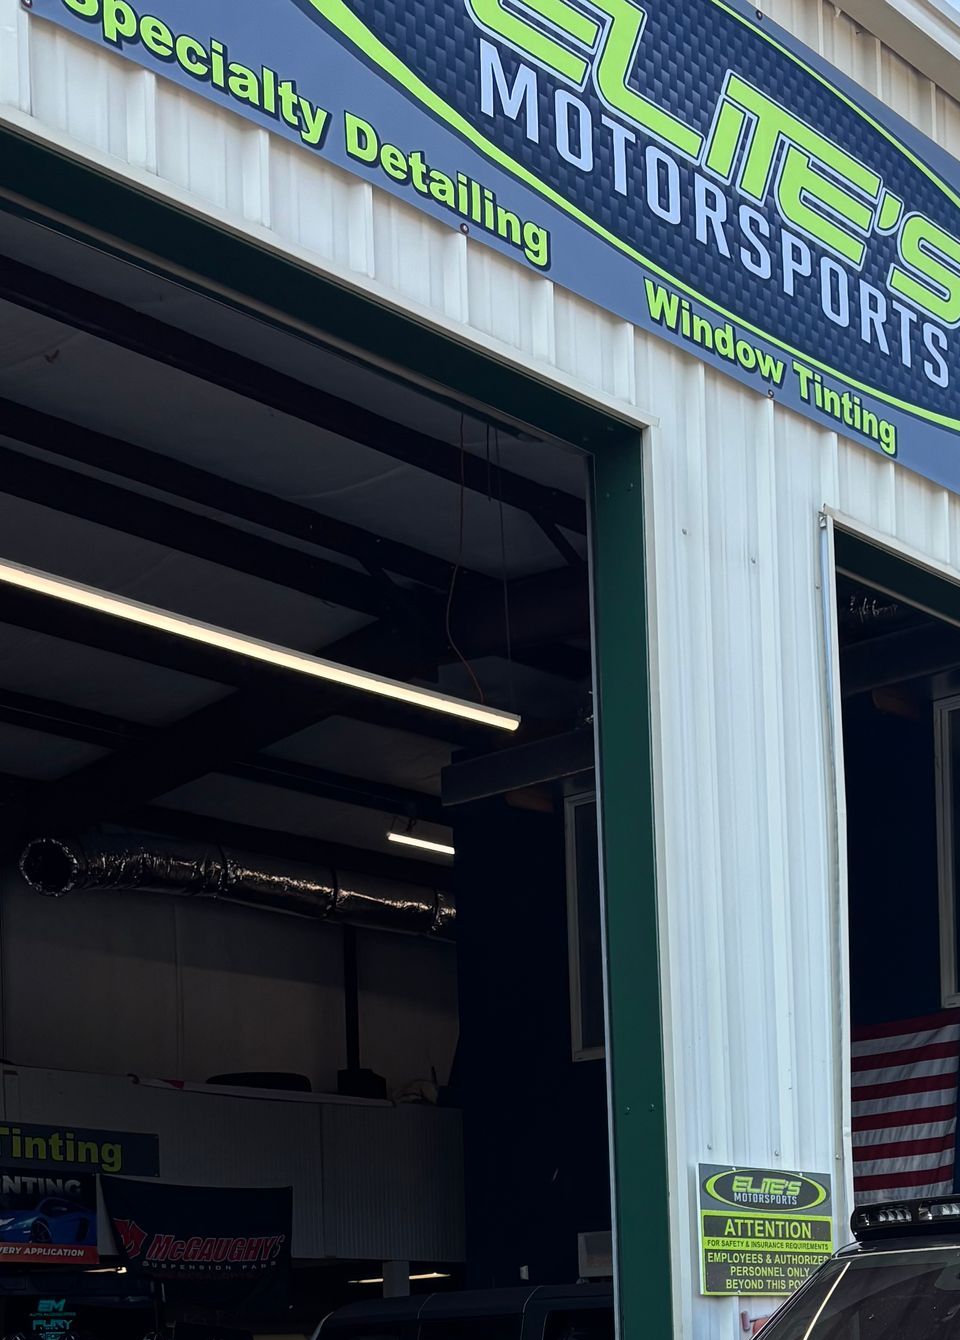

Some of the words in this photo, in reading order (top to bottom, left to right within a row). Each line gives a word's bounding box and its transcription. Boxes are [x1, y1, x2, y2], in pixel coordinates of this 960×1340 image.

[345, 112, 549, 267] Detailing
[480, 38, 949, 388] MOTORSPORTS
[643, 278, 784, 384] Window
[793, 367, 896, 455] Tinting
[732, 1176, 802, 1195] ELITE'S
[734, 1193, 798, 1205] MOTORSPORTS
[724, 1218, 812, 1239] ATTENTION
[707, 1239, 719, 1247] FOR
[721, 1240, 744, 1248] SAFETY
[751, 1241, 784, 1249] INSURANCE
[785, 1242, 829, 1251] REQUIREMENTS
[23, 1247, 84, 1257] APPLICATION
[708, 1252, 763, 1264] EMPLOYEES
[766, 1254, 772, 1264] &
[731, 1266, 784, 1277] PERSONNEL
[726, 1279, 764, 1290] BEYOND
[766, 1279, 786, 1290] THIS
